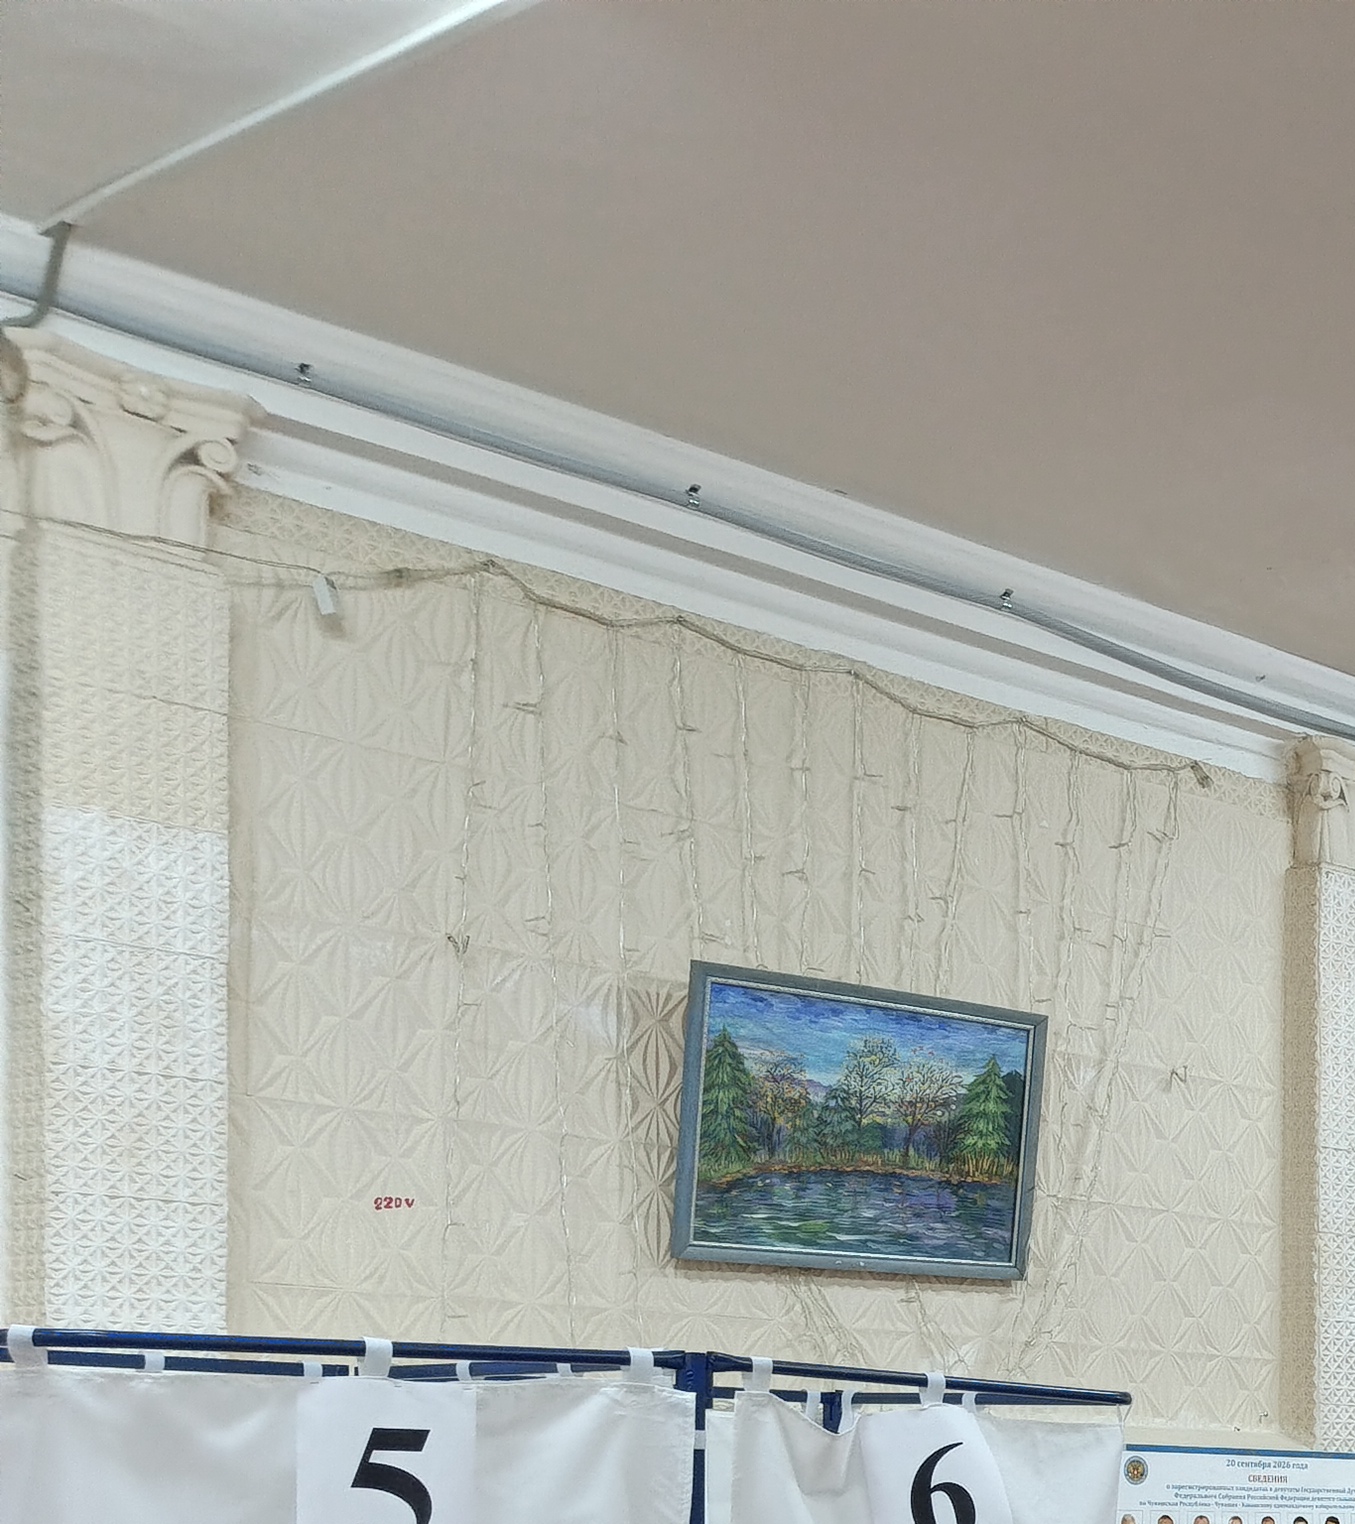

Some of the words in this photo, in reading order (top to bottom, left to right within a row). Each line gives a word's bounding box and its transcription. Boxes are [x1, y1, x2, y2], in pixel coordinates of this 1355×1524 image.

[1226, 1459, 1236, 1467] 20
[1237, 1460, 1271, 1470] сентября
[1292, 1462, 1309, 1470] года
[1248, 1474, 1288, 1483] СВЕДЕНИЯ
